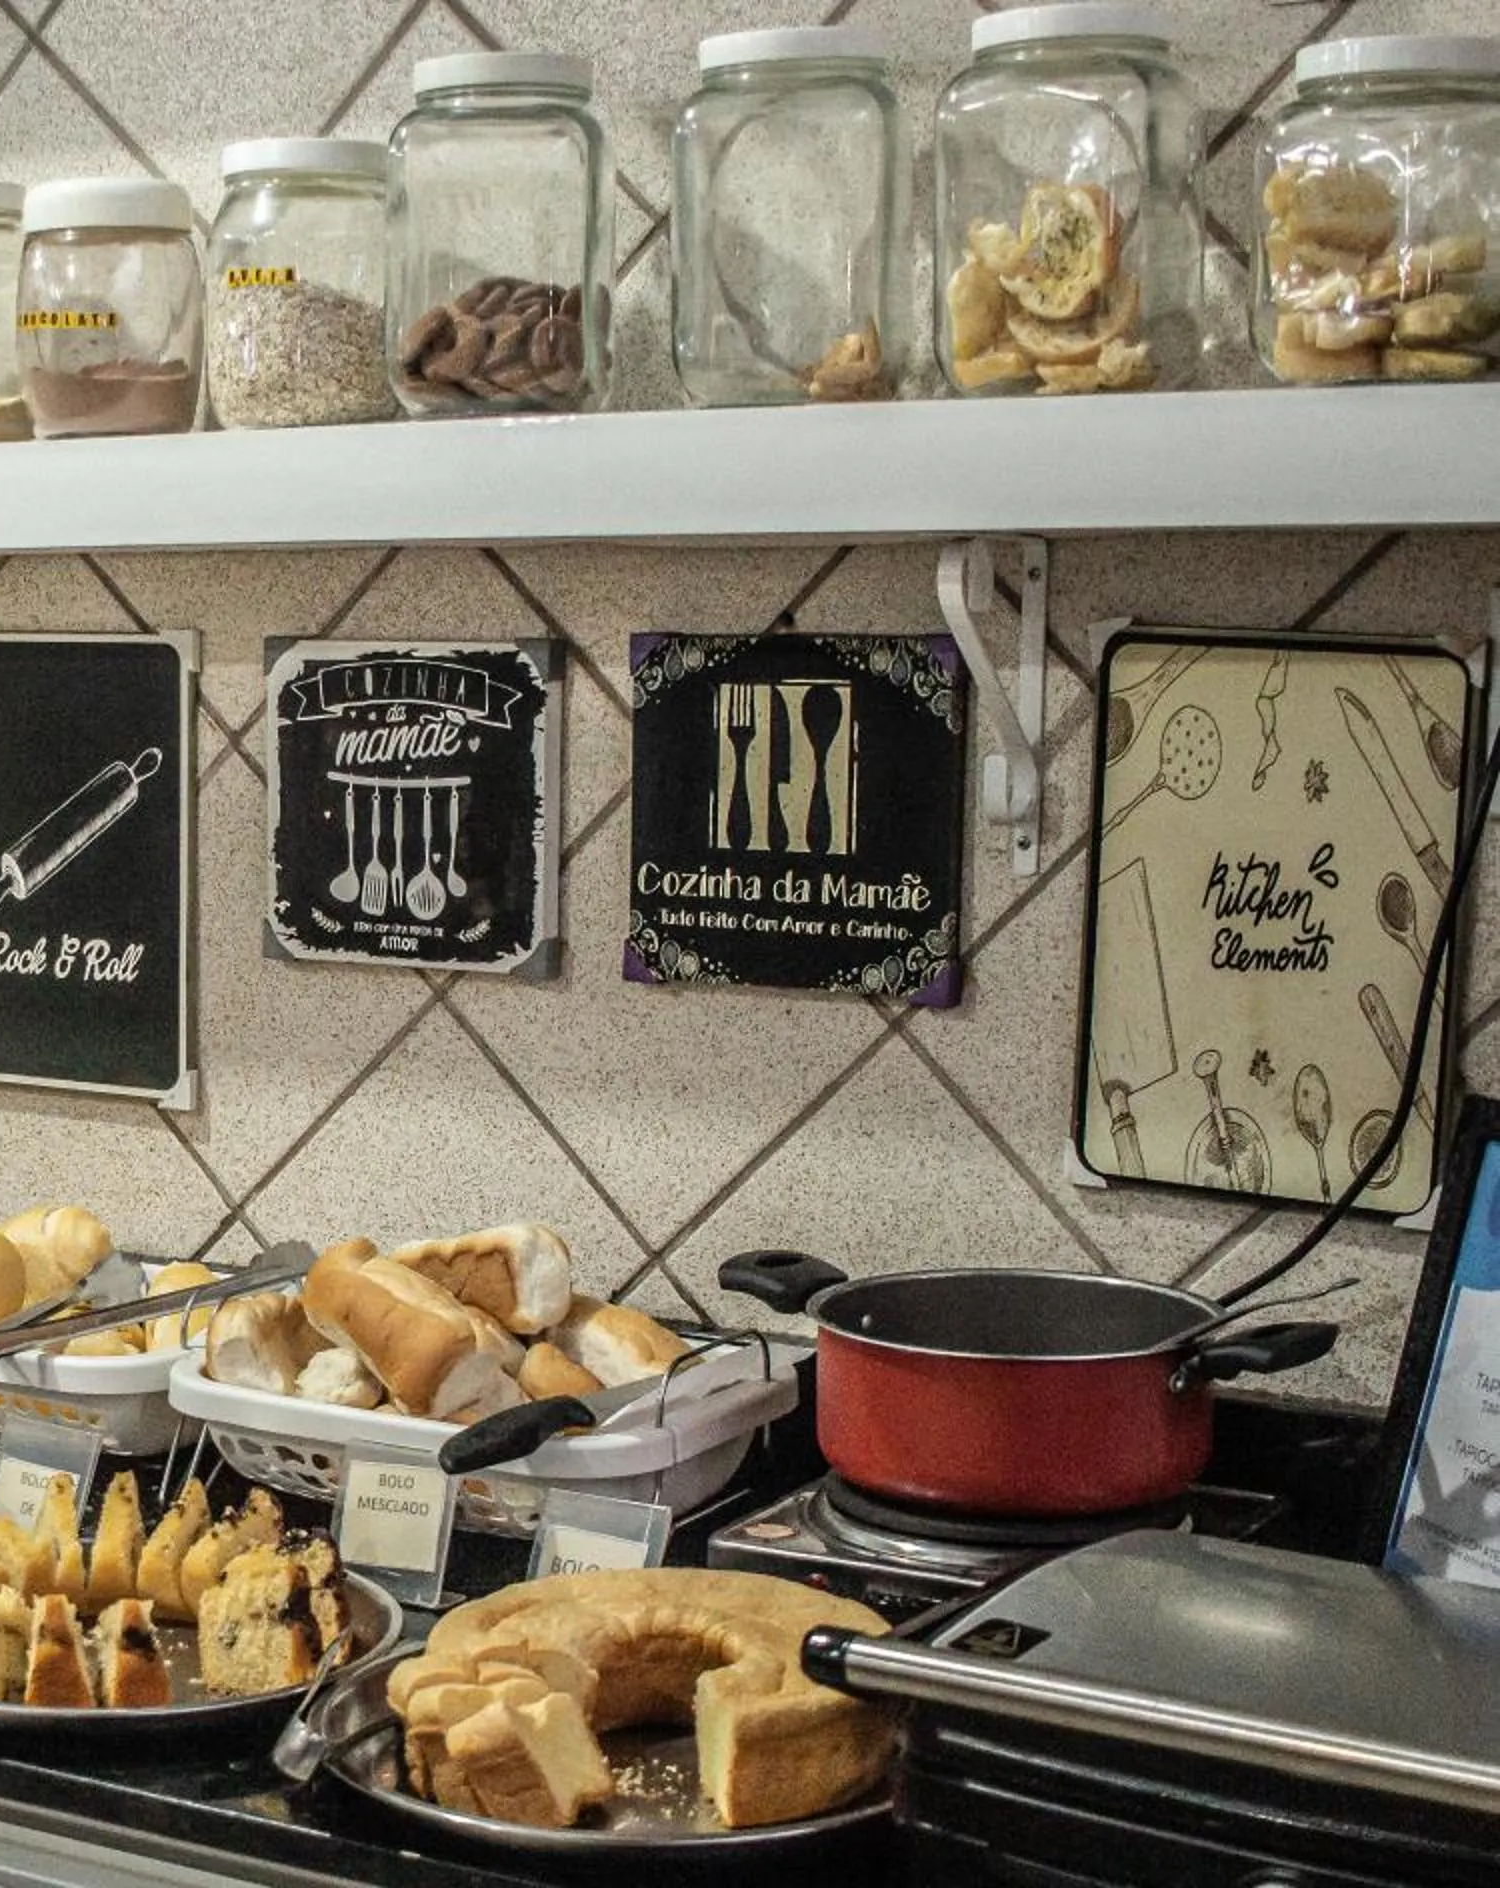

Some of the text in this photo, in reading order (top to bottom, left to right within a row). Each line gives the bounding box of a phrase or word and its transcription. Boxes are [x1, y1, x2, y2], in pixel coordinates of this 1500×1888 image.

[344, 666, 466, 705] COZINHA
[334, 711, 463, 767] mamãe
[636, 860, 932, 912] Cozinha da Mamãe
[379, 935, 420, 952] AMOR
[659, 907, 696, 927] Tudo
[699, 910, 738, 929] Feito
[781, 915, 826, 935] Amor
[829, 922, 841, 937] e
[846, 919, 910, 941] Carinho
[53, 933, 81, 980] &
[82, 938, 146, 983] Roll
[1210, 919, 1336, 973] Elements
[379, 1472, 416, 1490] BOLO
[356, 1495, 430, 1517] MESCLADO
